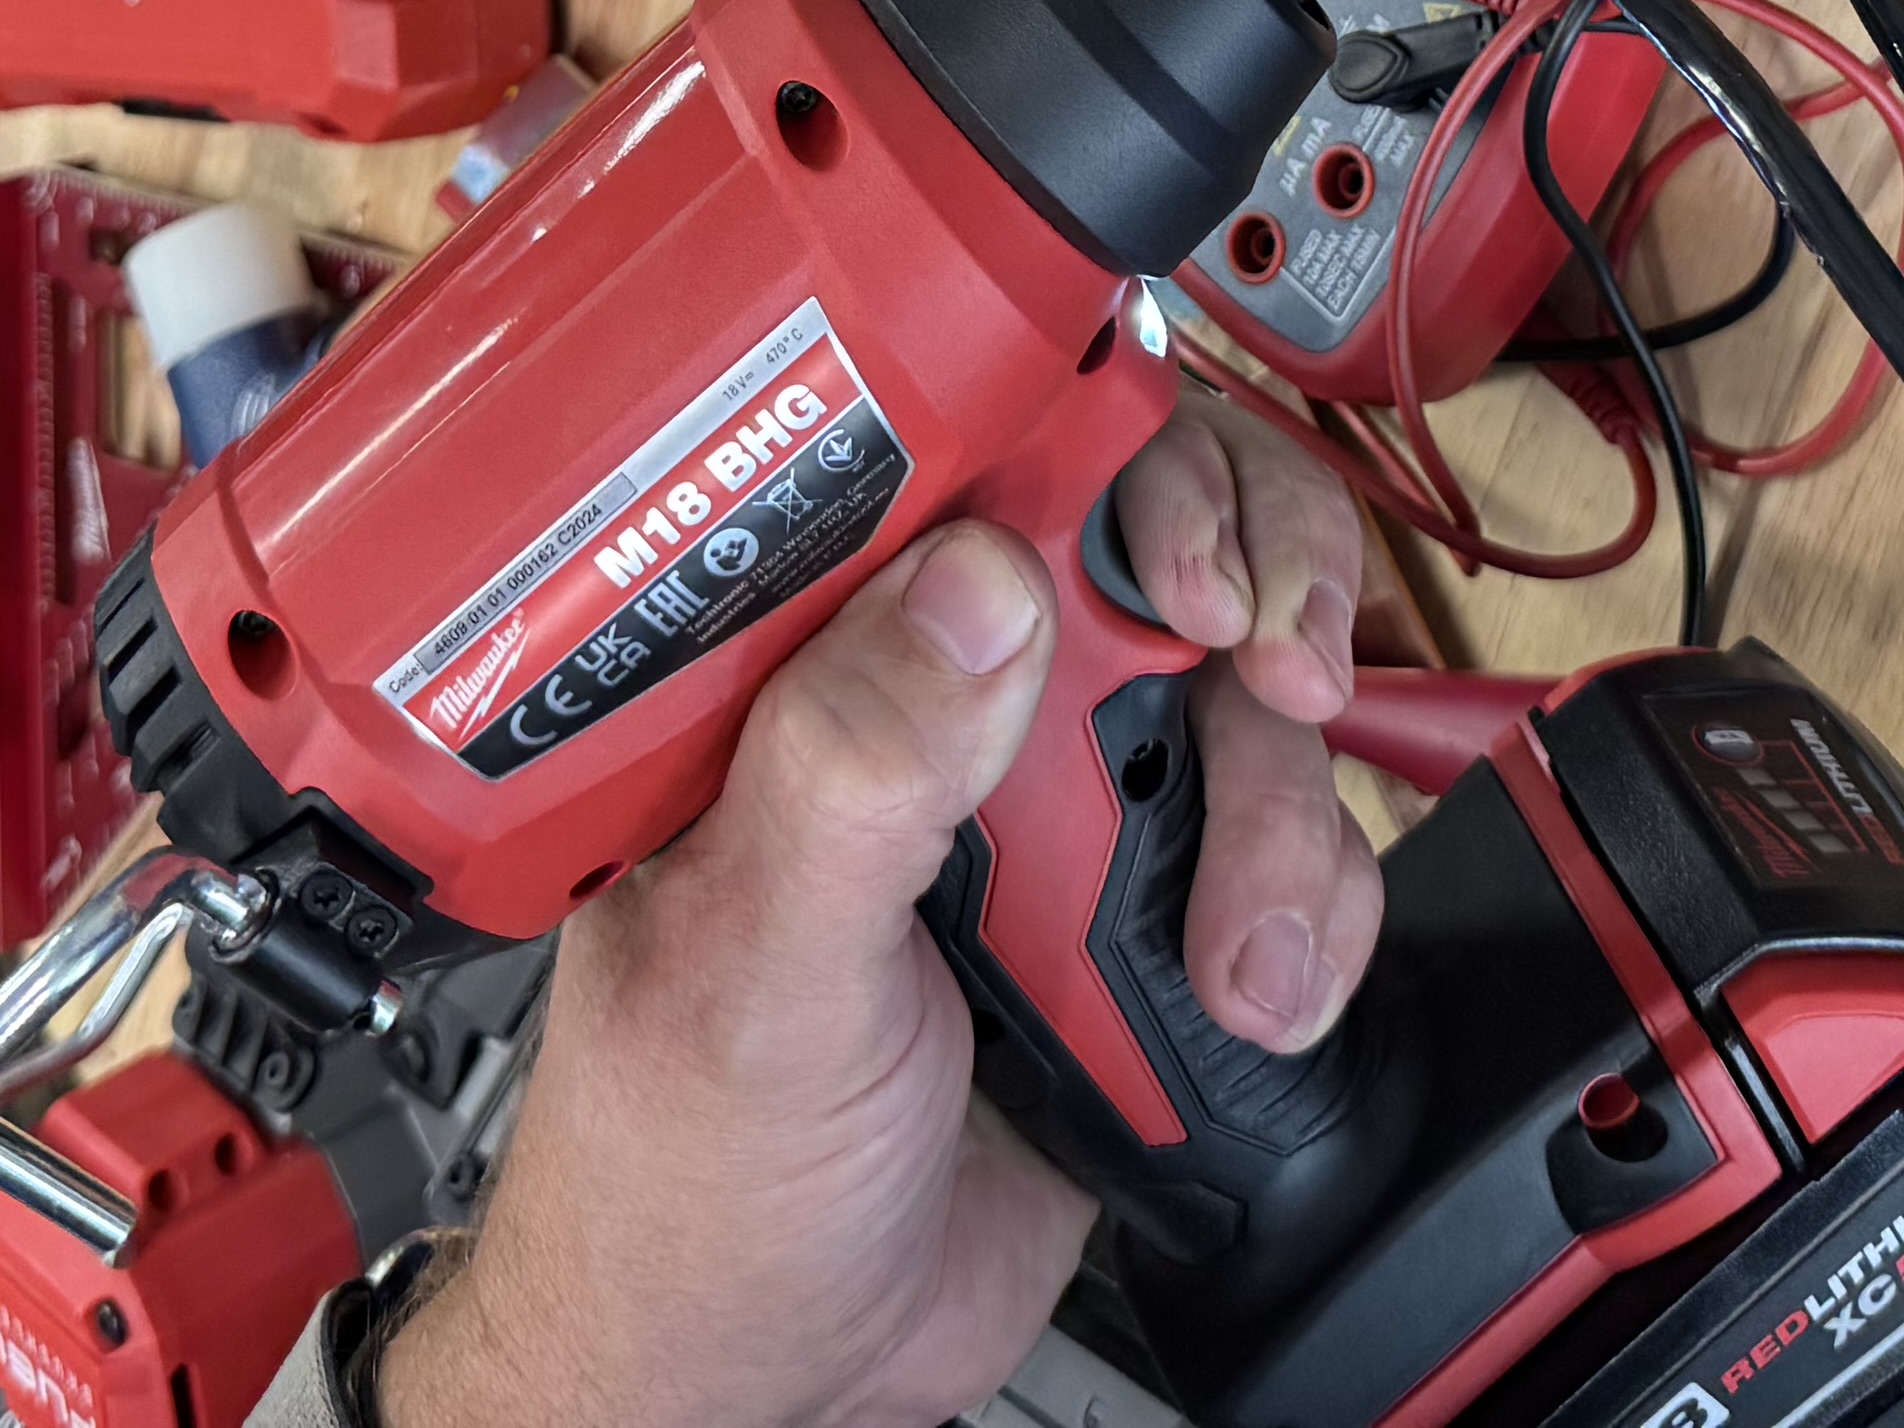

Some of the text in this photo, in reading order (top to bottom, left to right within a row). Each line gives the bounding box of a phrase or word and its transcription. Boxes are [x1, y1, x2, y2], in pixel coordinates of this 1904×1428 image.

[721, 382, 741, 402] 18
[789, 326, 804, 342] C
[593, 481, 712, 589] M18
[703, 384, 827, 494] BHG
[847, 452, 897, 497] Germany
[386, 659, 425, 695] Code:
[465, 602, 490, 627] 01
[485, 585, 509, 609] 01
[554, 501, 605, 548] C2024
[697, 590, 757, 644] Industries
[429, 608, 527, 729] Milwaukee
[575, 622, 632, 671] UK
[597, 645, 652, 687] CA
